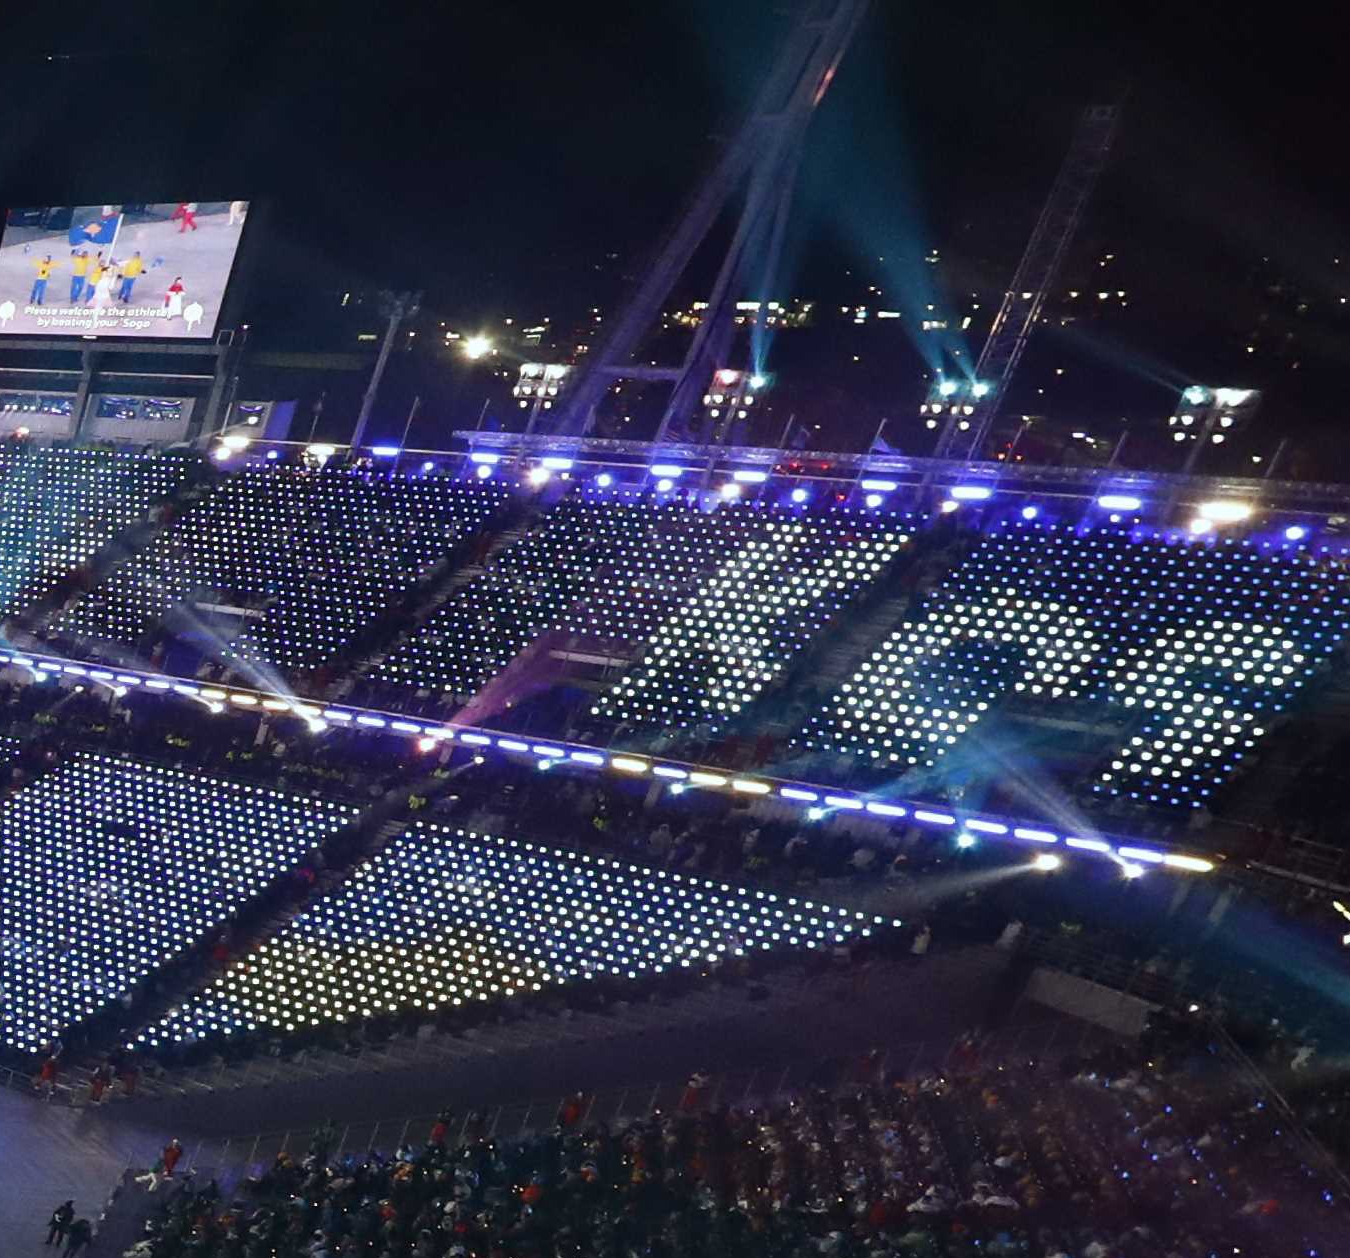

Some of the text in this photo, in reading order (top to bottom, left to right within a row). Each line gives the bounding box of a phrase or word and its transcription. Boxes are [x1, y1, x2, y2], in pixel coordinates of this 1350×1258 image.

[24, 305, 58, 315] Please
[108, 305, 126, 316] the
[127, 306, 171, 318] athlete
[37, 317, 52, 328] by
[52, 317, 92, 330] beating
